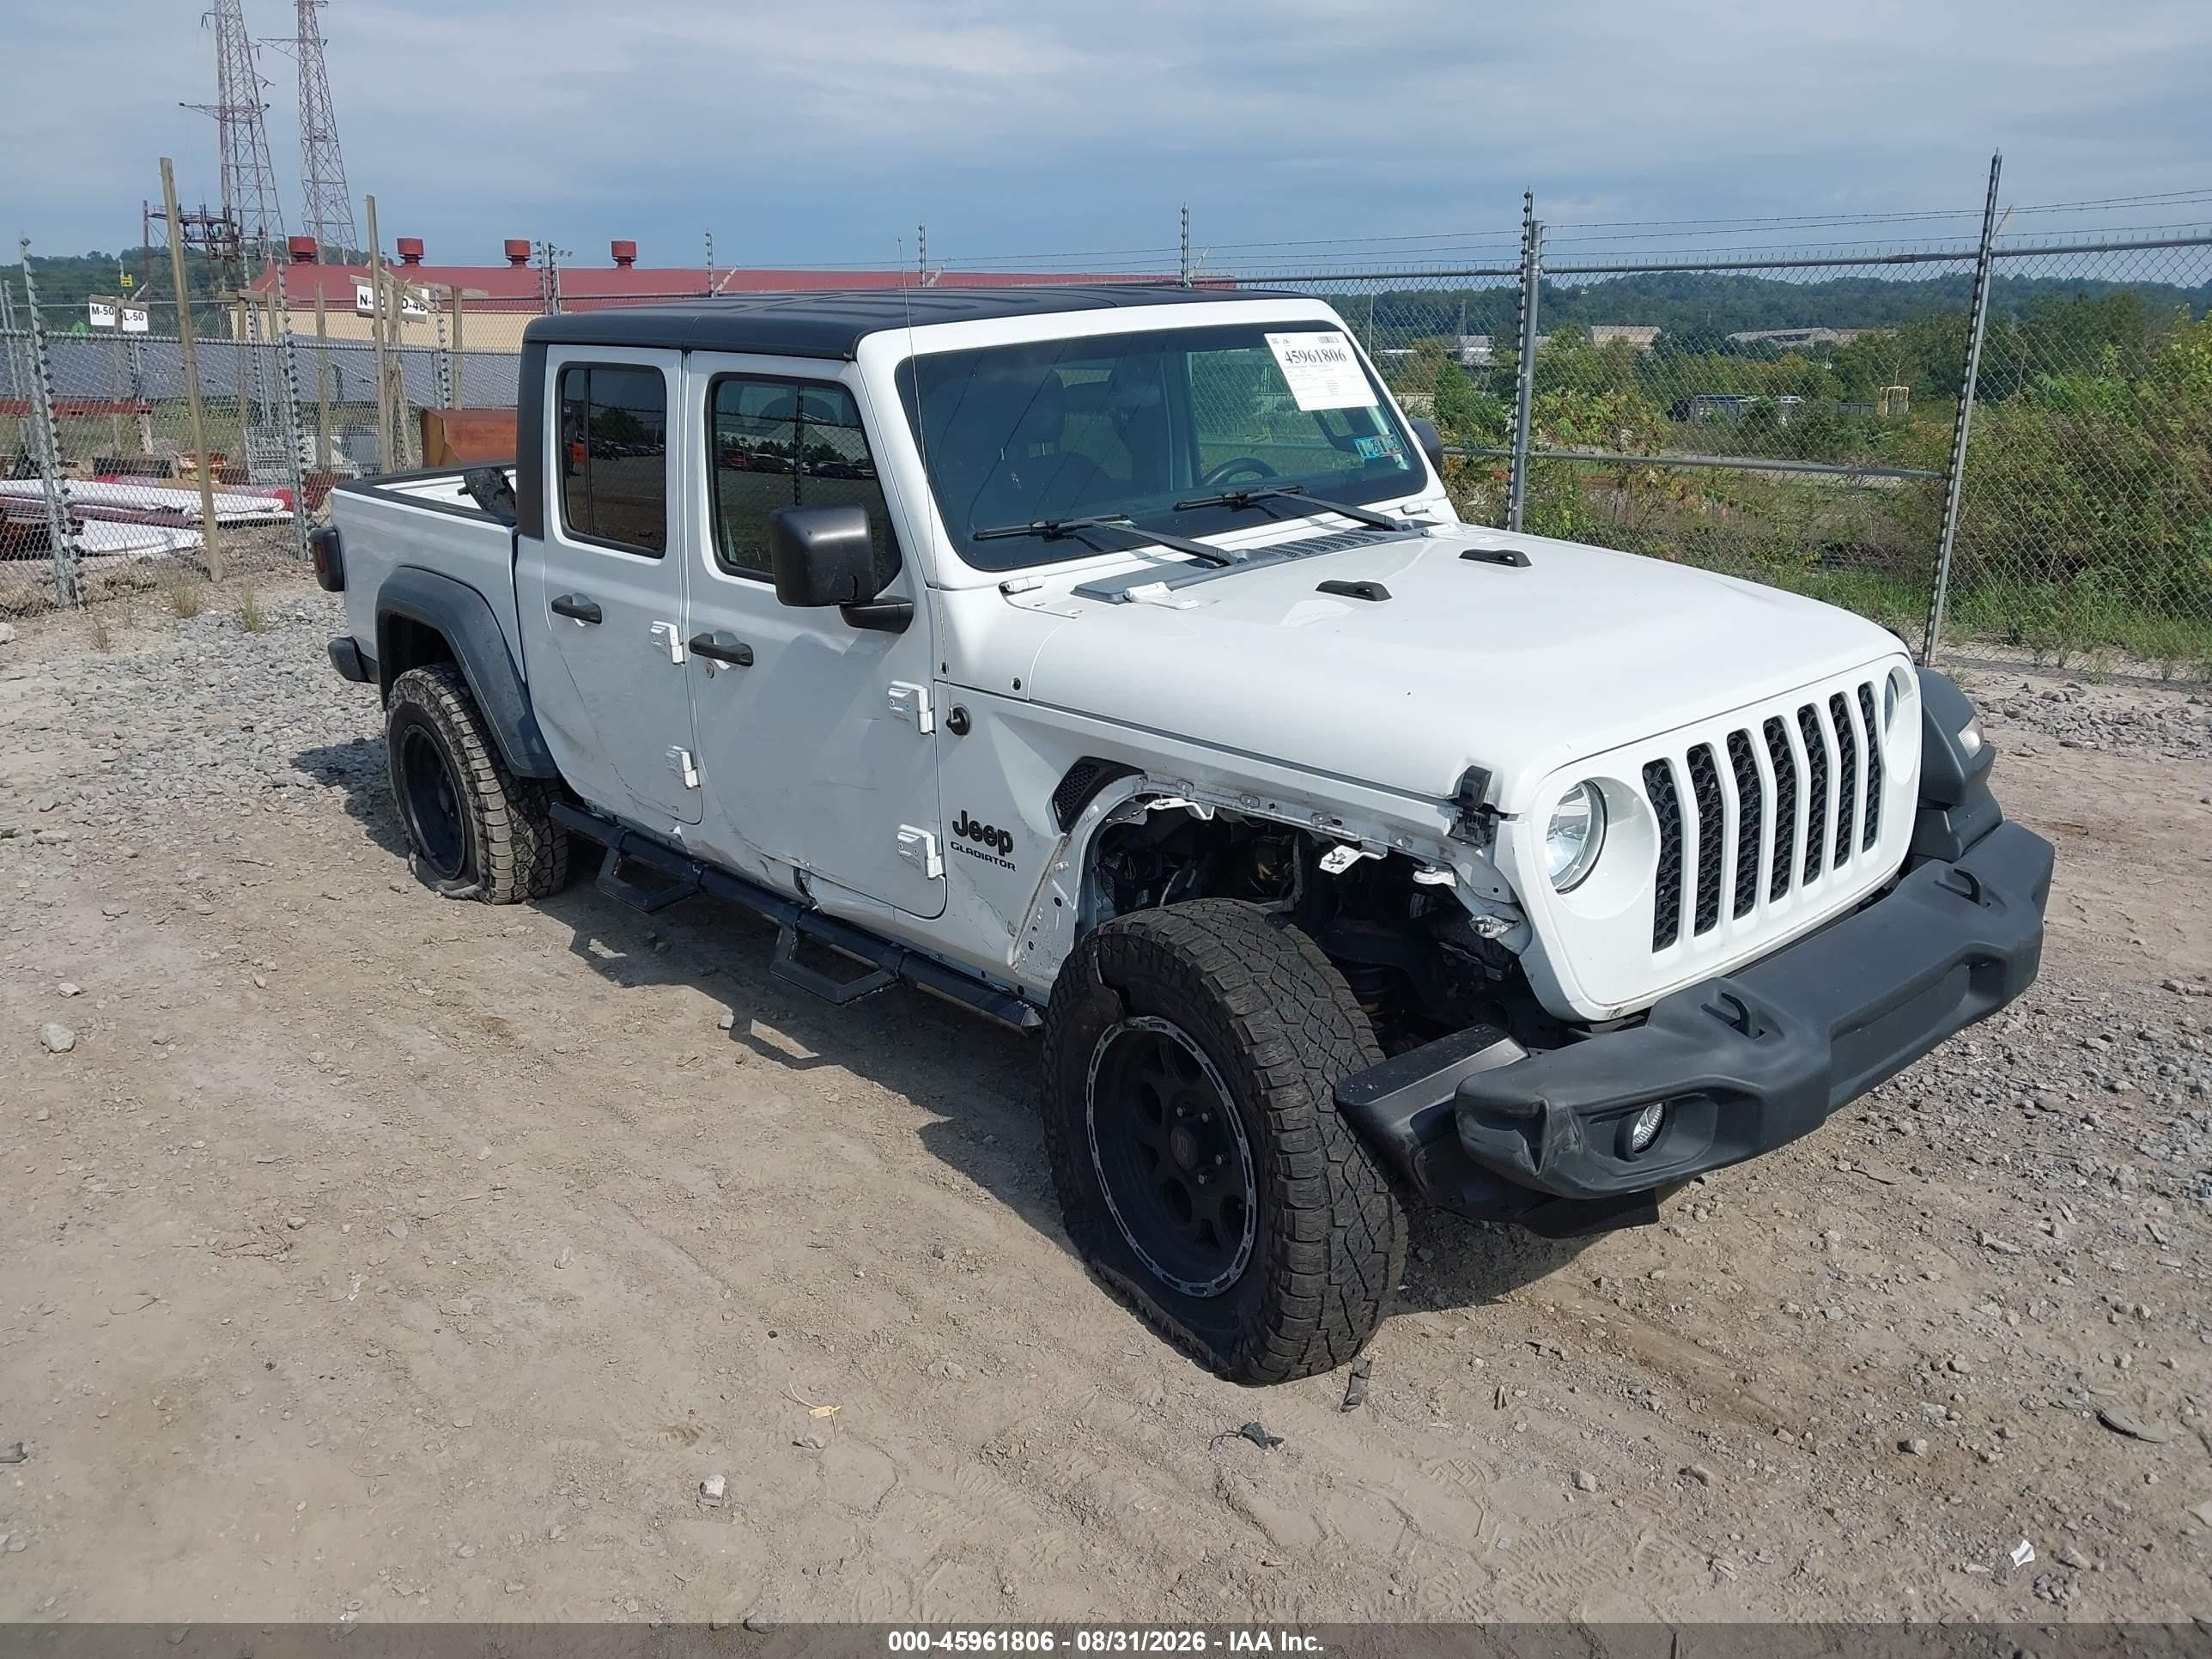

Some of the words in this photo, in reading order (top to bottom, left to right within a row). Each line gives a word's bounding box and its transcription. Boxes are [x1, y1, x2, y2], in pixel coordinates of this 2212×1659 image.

[91, 305, 114, 316] M-50
[124, 312, 144, 321] L-50
[1285, 348, 1347, 364] 45961806
[951, 810, 1014, 857] Jeep
[950, 841, 1017, 872] GLADIATOR
